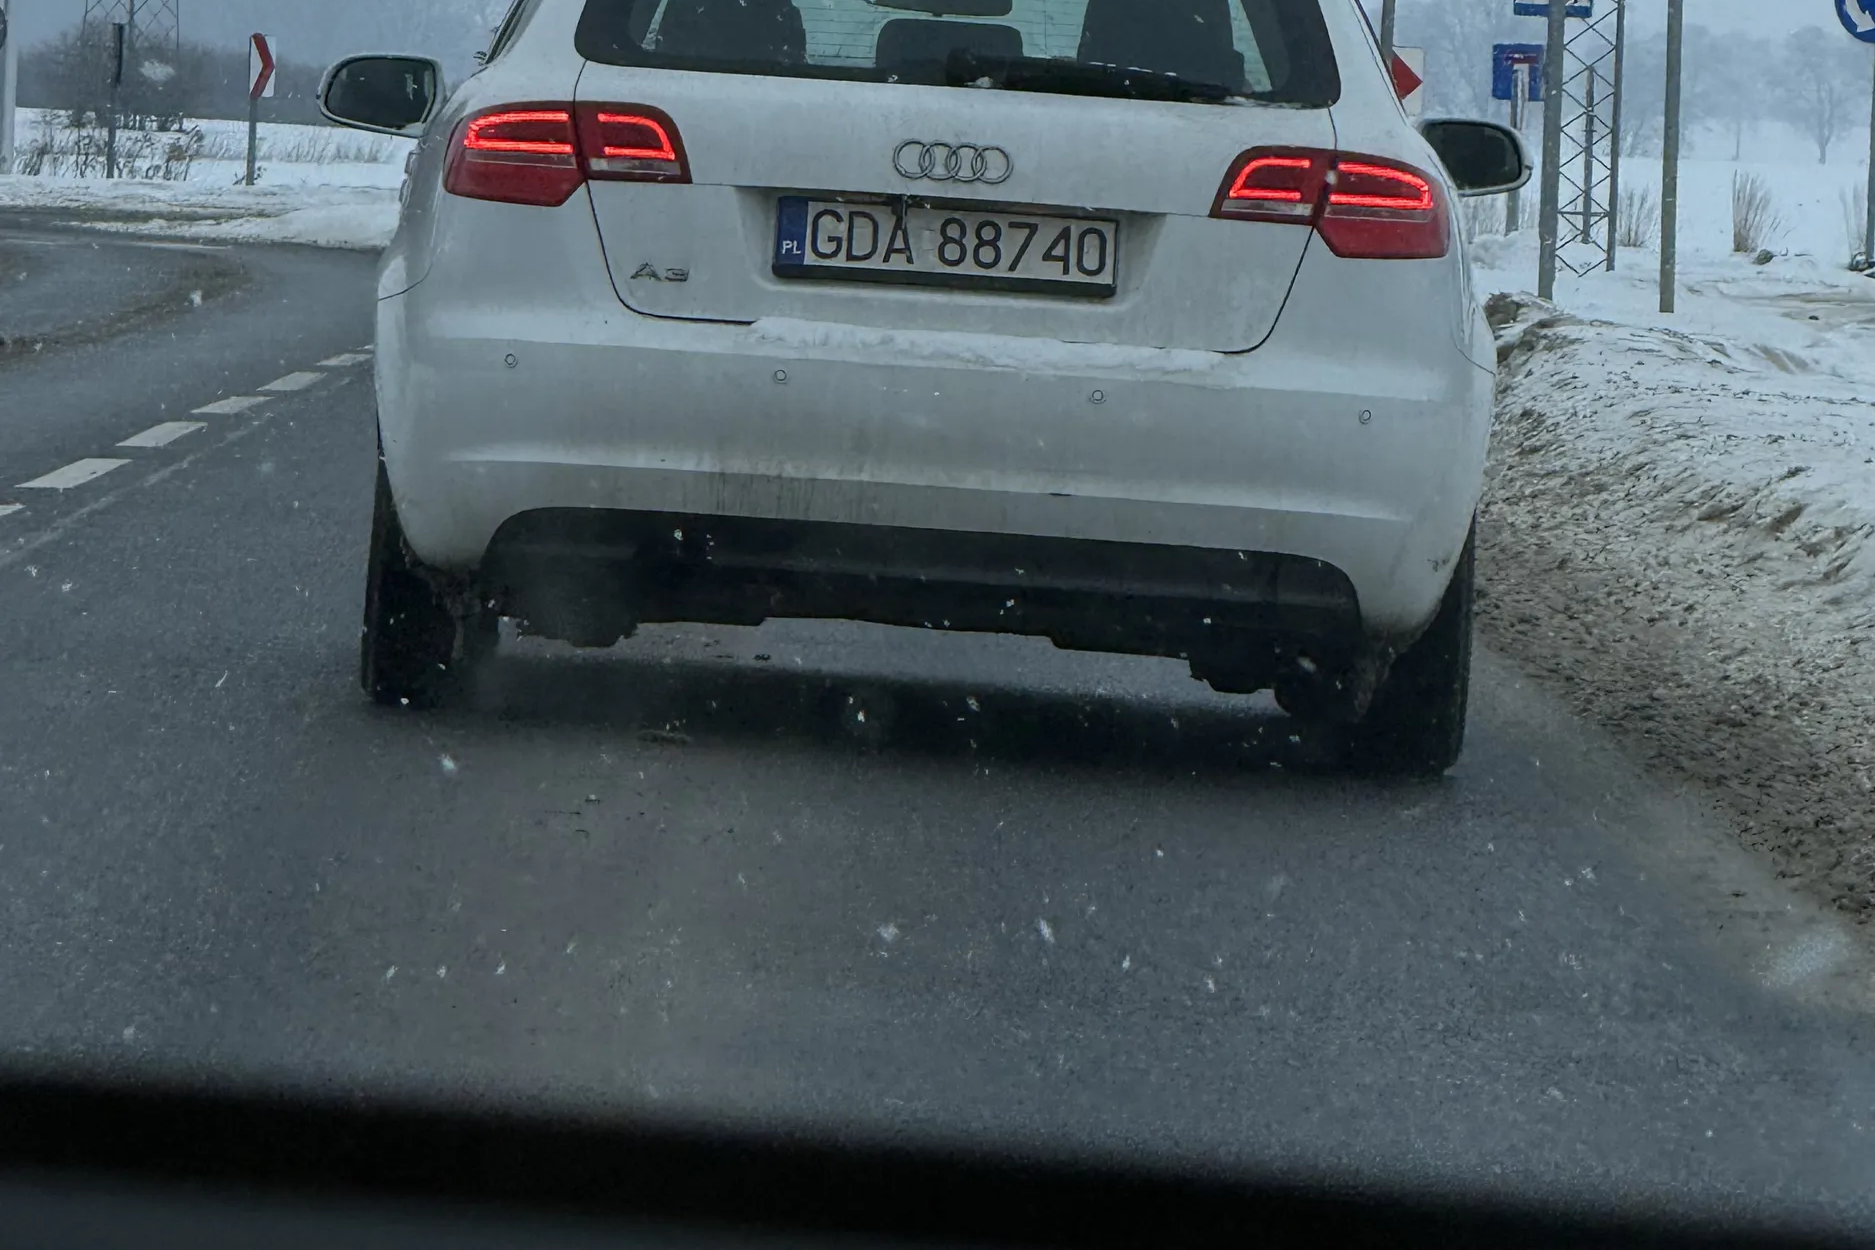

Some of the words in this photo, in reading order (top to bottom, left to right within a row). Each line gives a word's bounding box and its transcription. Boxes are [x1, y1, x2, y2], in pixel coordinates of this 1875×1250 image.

[782, 239, 801, 255] PL
[810, 208, 914, 265] GDA
[937, 216, 1107, 277] 88740
[630, 262, 690, 282] A3
